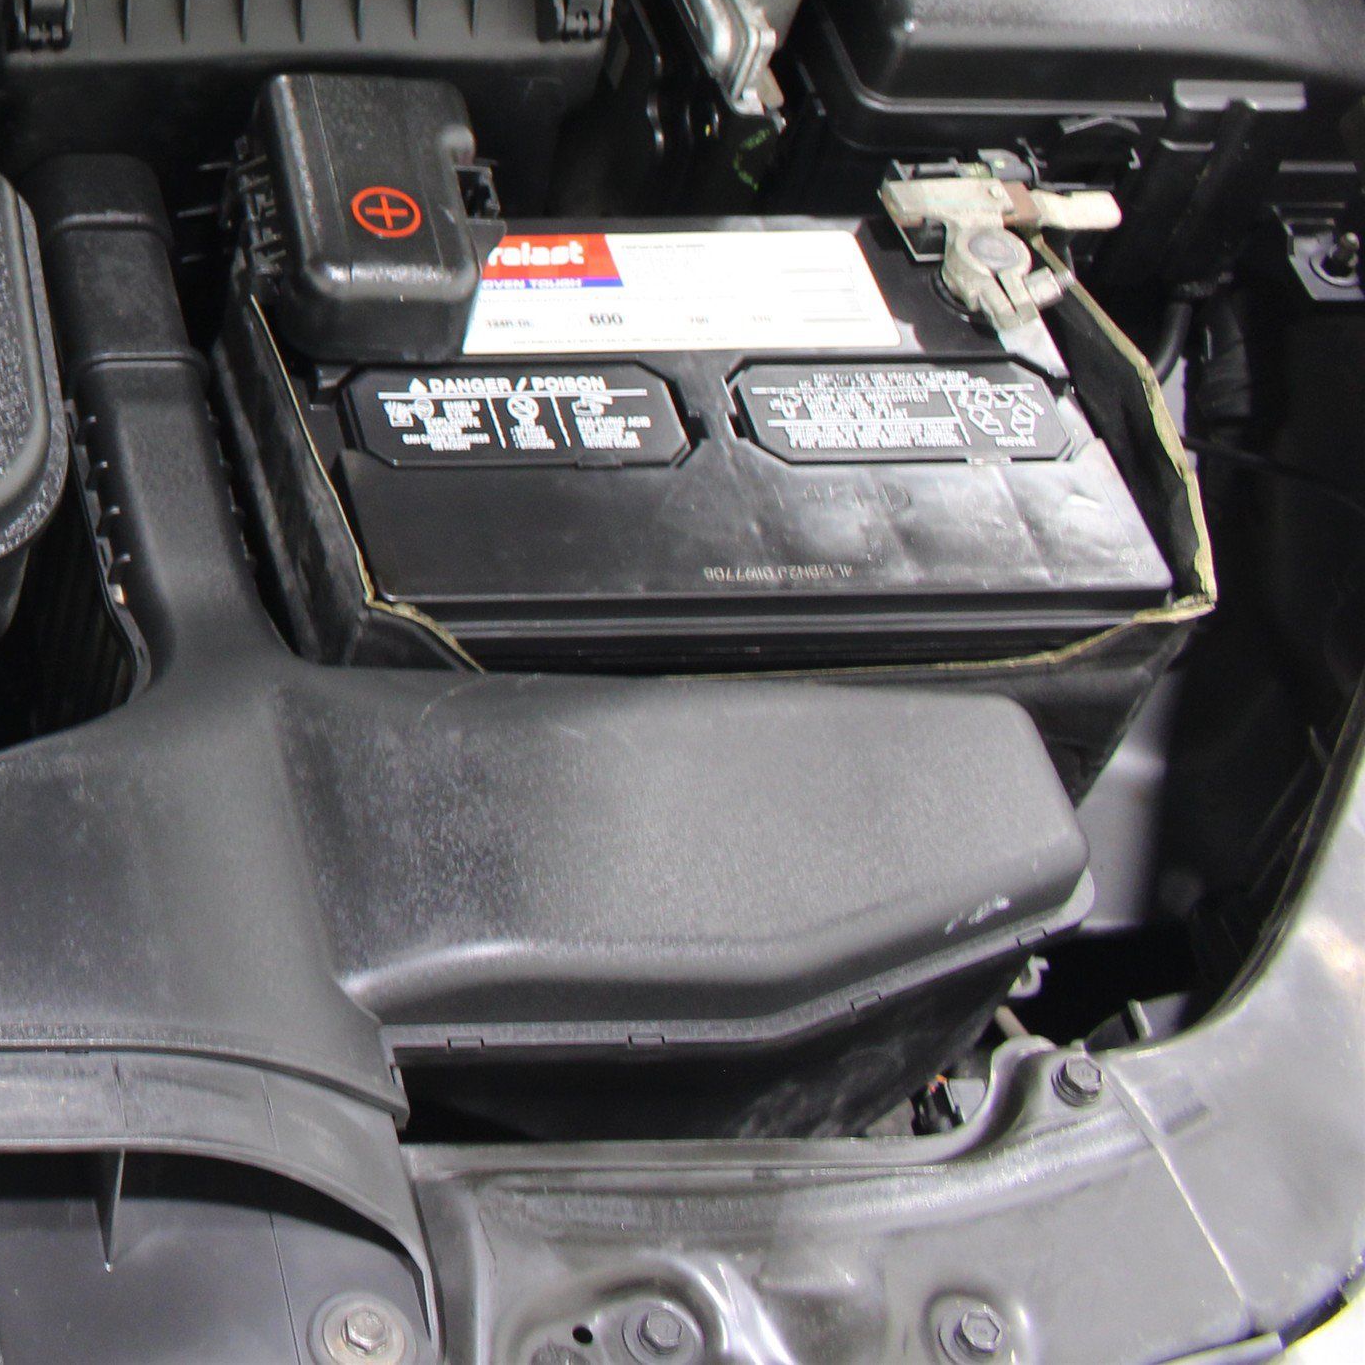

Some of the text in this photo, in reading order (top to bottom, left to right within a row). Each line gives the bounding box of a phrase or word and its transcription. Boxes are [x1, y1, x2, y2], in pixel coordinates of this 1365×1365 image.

[589, 312, 623, 326] 600
[429, 377, 512, 393] DANGER
[532, 376, 607, 392] POISON
